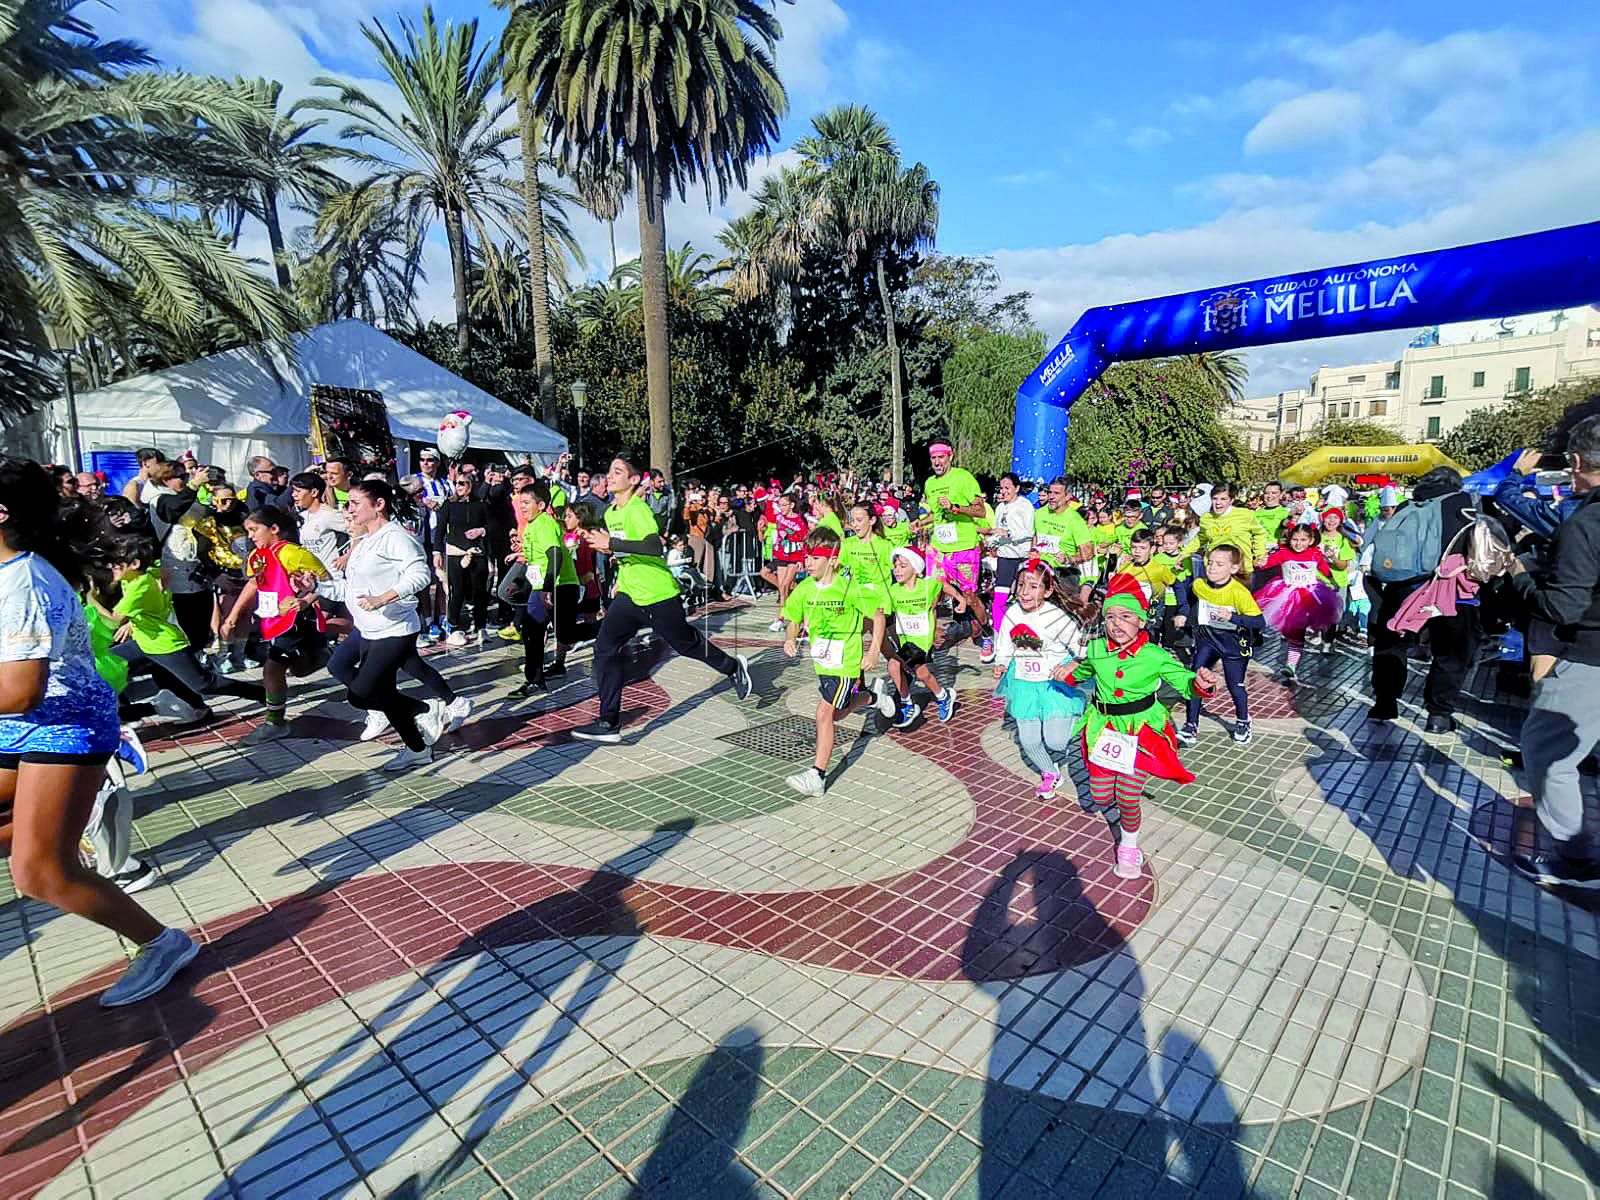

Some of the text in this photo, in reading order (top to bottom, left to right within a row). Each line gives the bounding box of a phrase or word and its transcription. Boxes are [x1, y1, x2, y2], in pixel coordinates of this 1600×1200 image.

[1264, 278, 1319, 295] CIUDAD
[1265, 277, 1418, 324] MELILLA
[1040, 343, 1073, 385] MELILLA
[1329, 455, 1349, 464] CLUB
[1387, 454, 1419, 463] MELILLA
[1024, 661, 1041, 673] 50
[1102, 742, 1122, 759] 49
